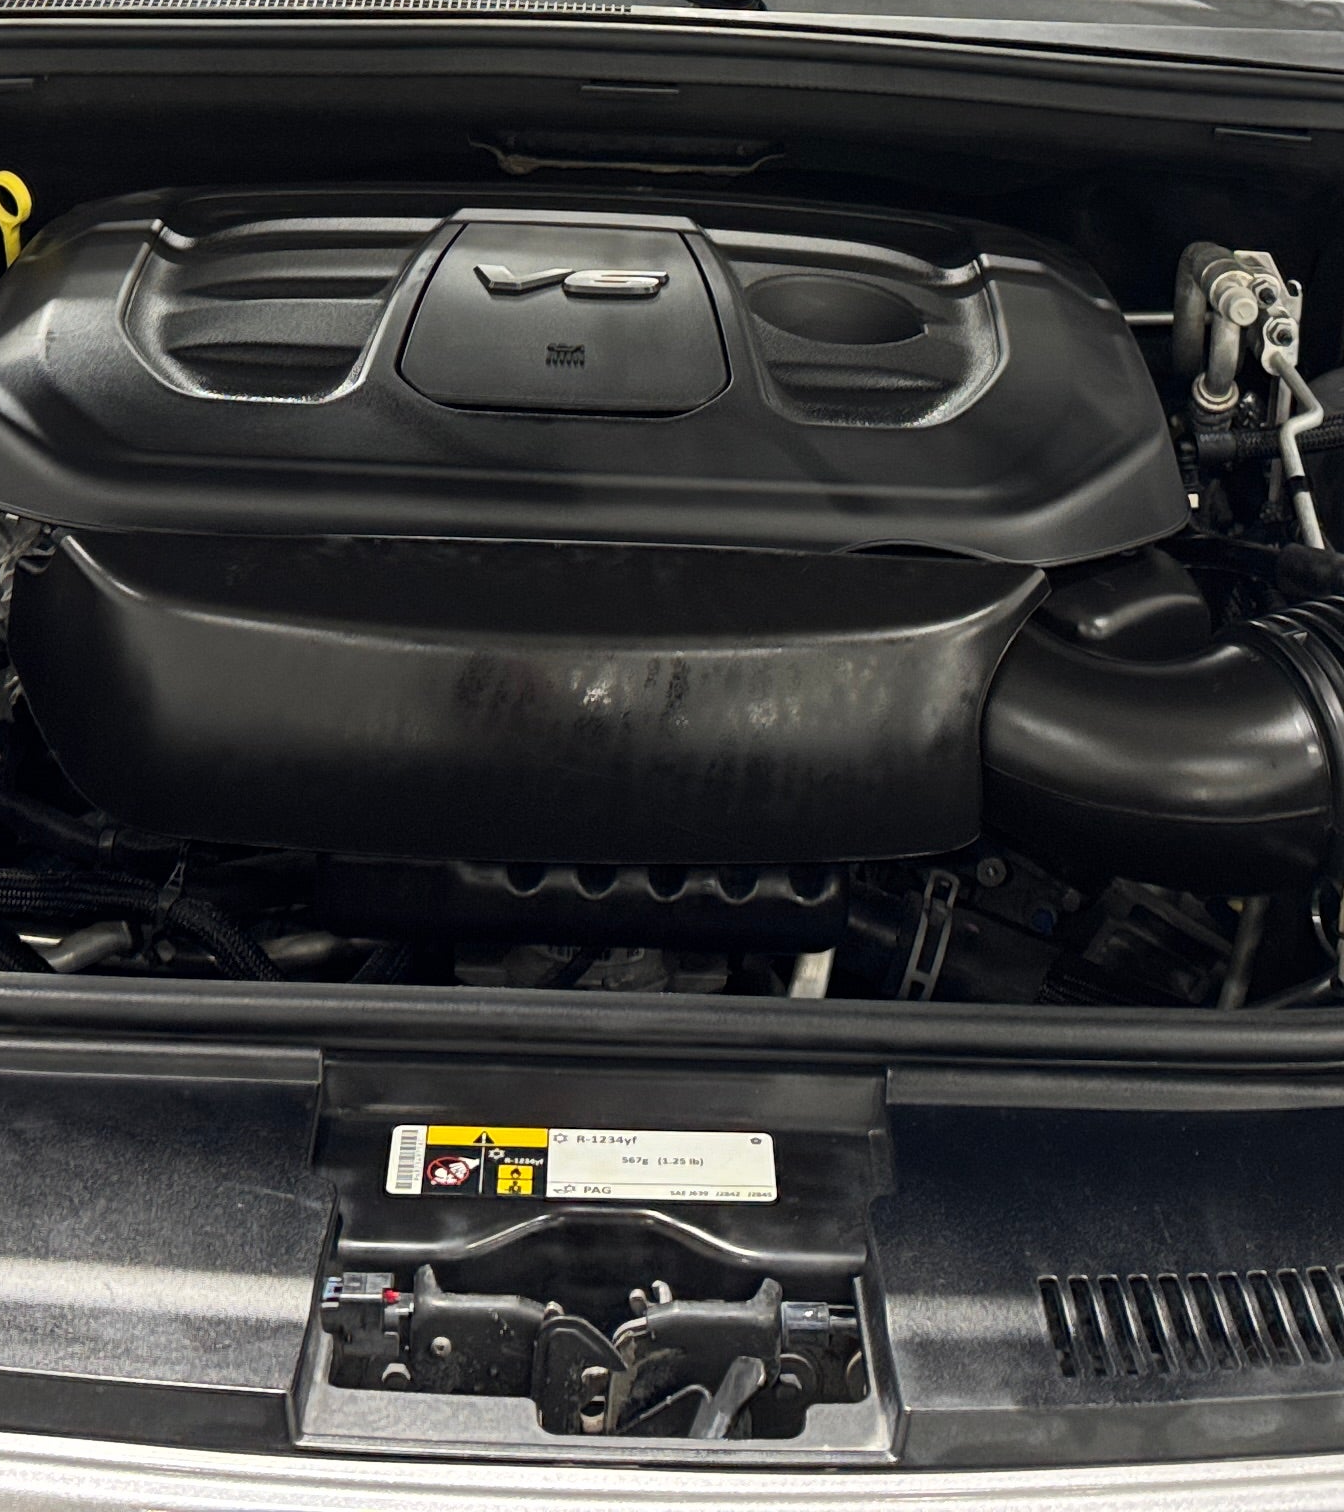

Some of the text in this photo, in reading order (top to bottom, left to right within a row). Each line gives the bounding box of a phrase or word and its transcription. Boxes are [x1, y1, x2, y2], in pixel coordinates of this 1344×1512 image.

[473, 264, 670, 299] V6
[576, 1135, 638, 1146] R-1234yf
[621, 1156, 704, 1167] 567g (1.25 lb)
[583, 1186, 612, 1195] PAG
